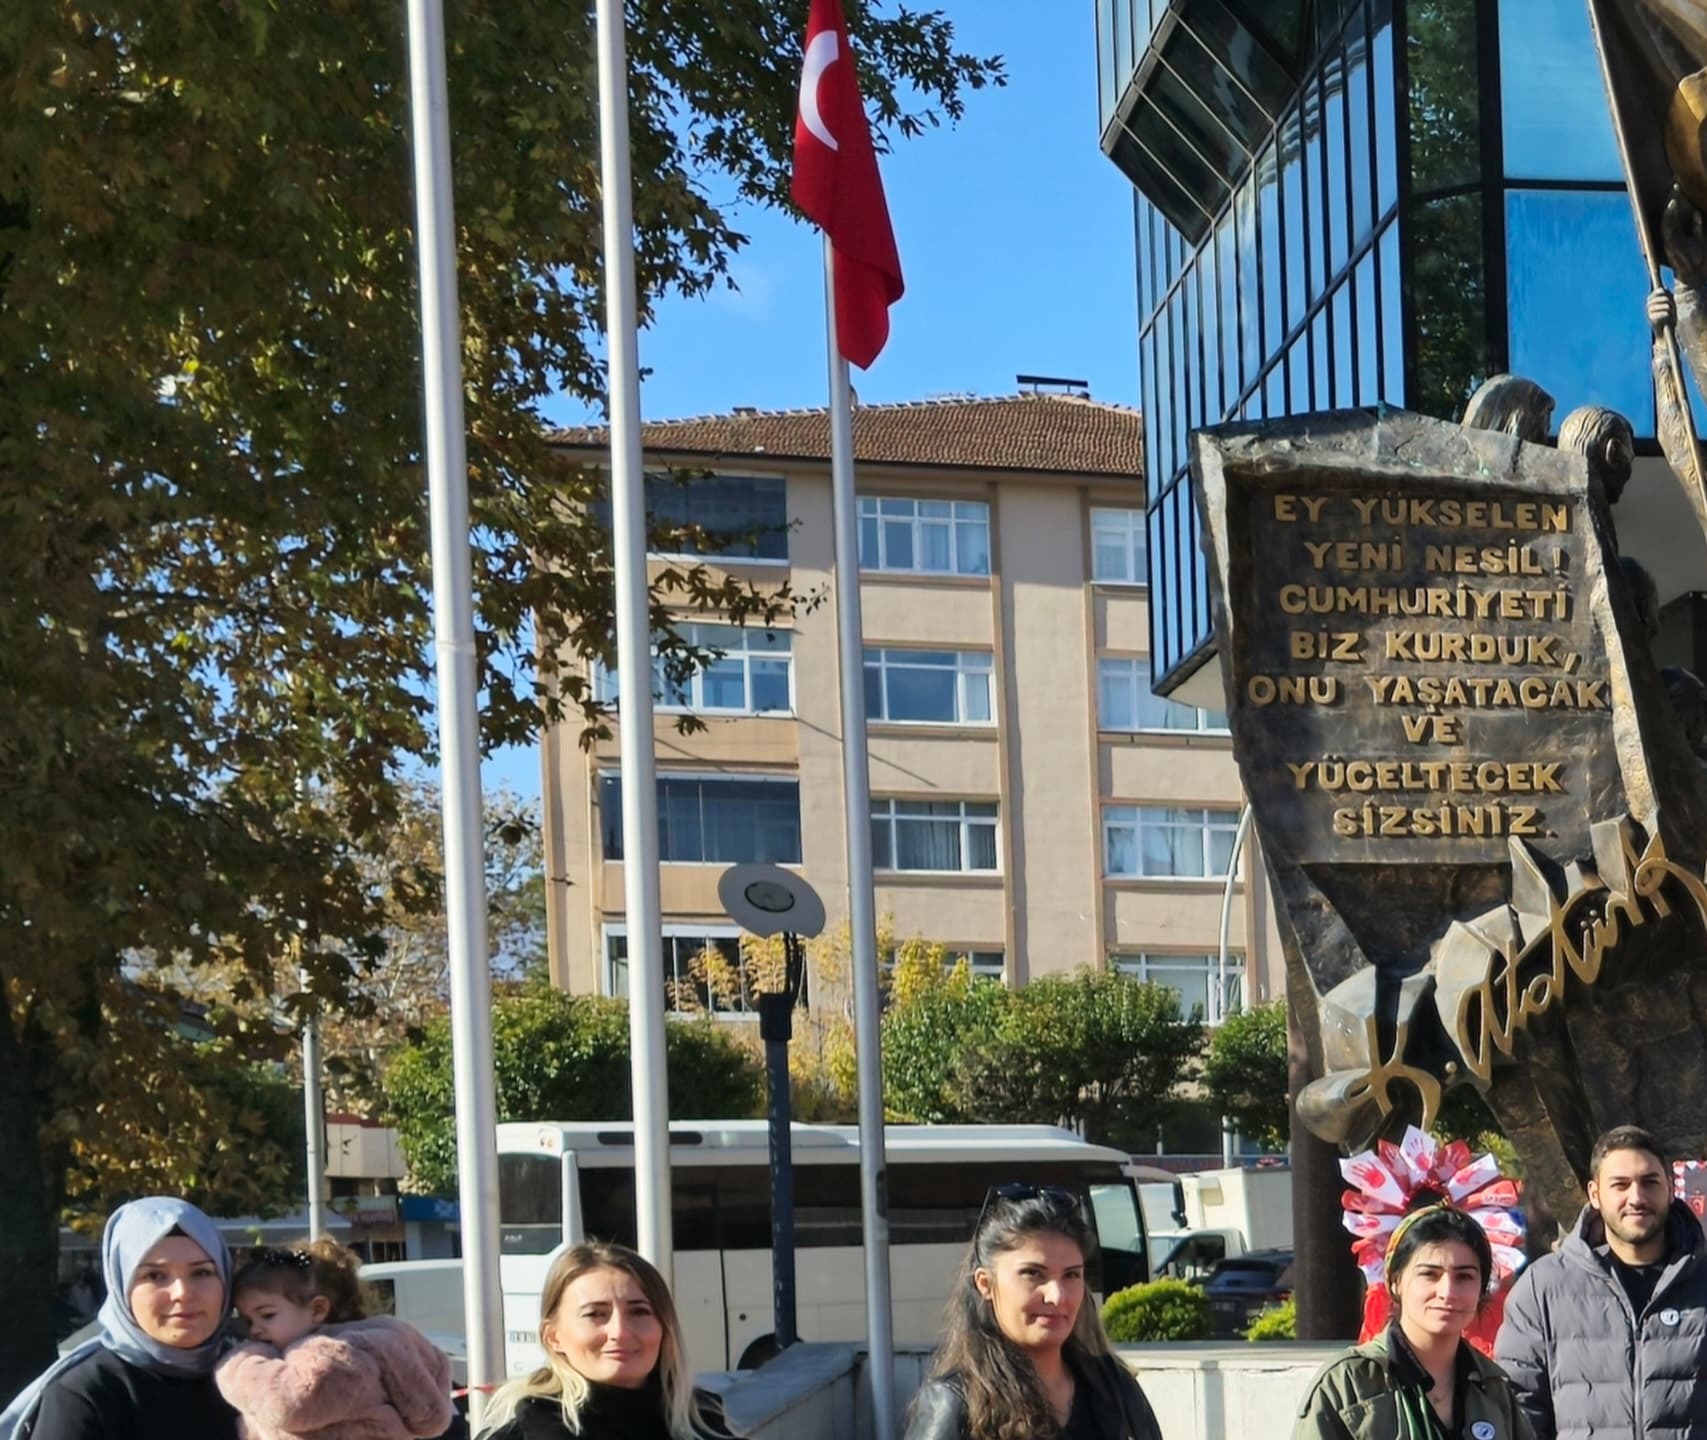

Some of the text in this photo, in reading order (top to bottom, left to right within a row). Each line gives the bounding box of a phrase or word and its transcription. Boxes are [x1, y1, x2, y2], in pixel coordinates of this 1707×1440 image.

[1275, 490, 1570, 534] EY YÜKSELEN
[1305, 535, 1405, 572] YENİ
[1279, 582, 1570, 622] CUMHURİYETİ
[1291, 624, 1582, 673] BİZ KURDUK,
[1248, 674, 1611, 717] ONU YAŞATACAK
[1402, 714, 1462, 745] VE
[1288, 754, 1566, 794] YÜCELTECEK
[1332, 801, 1558, 839] SİZSİNİZ.
